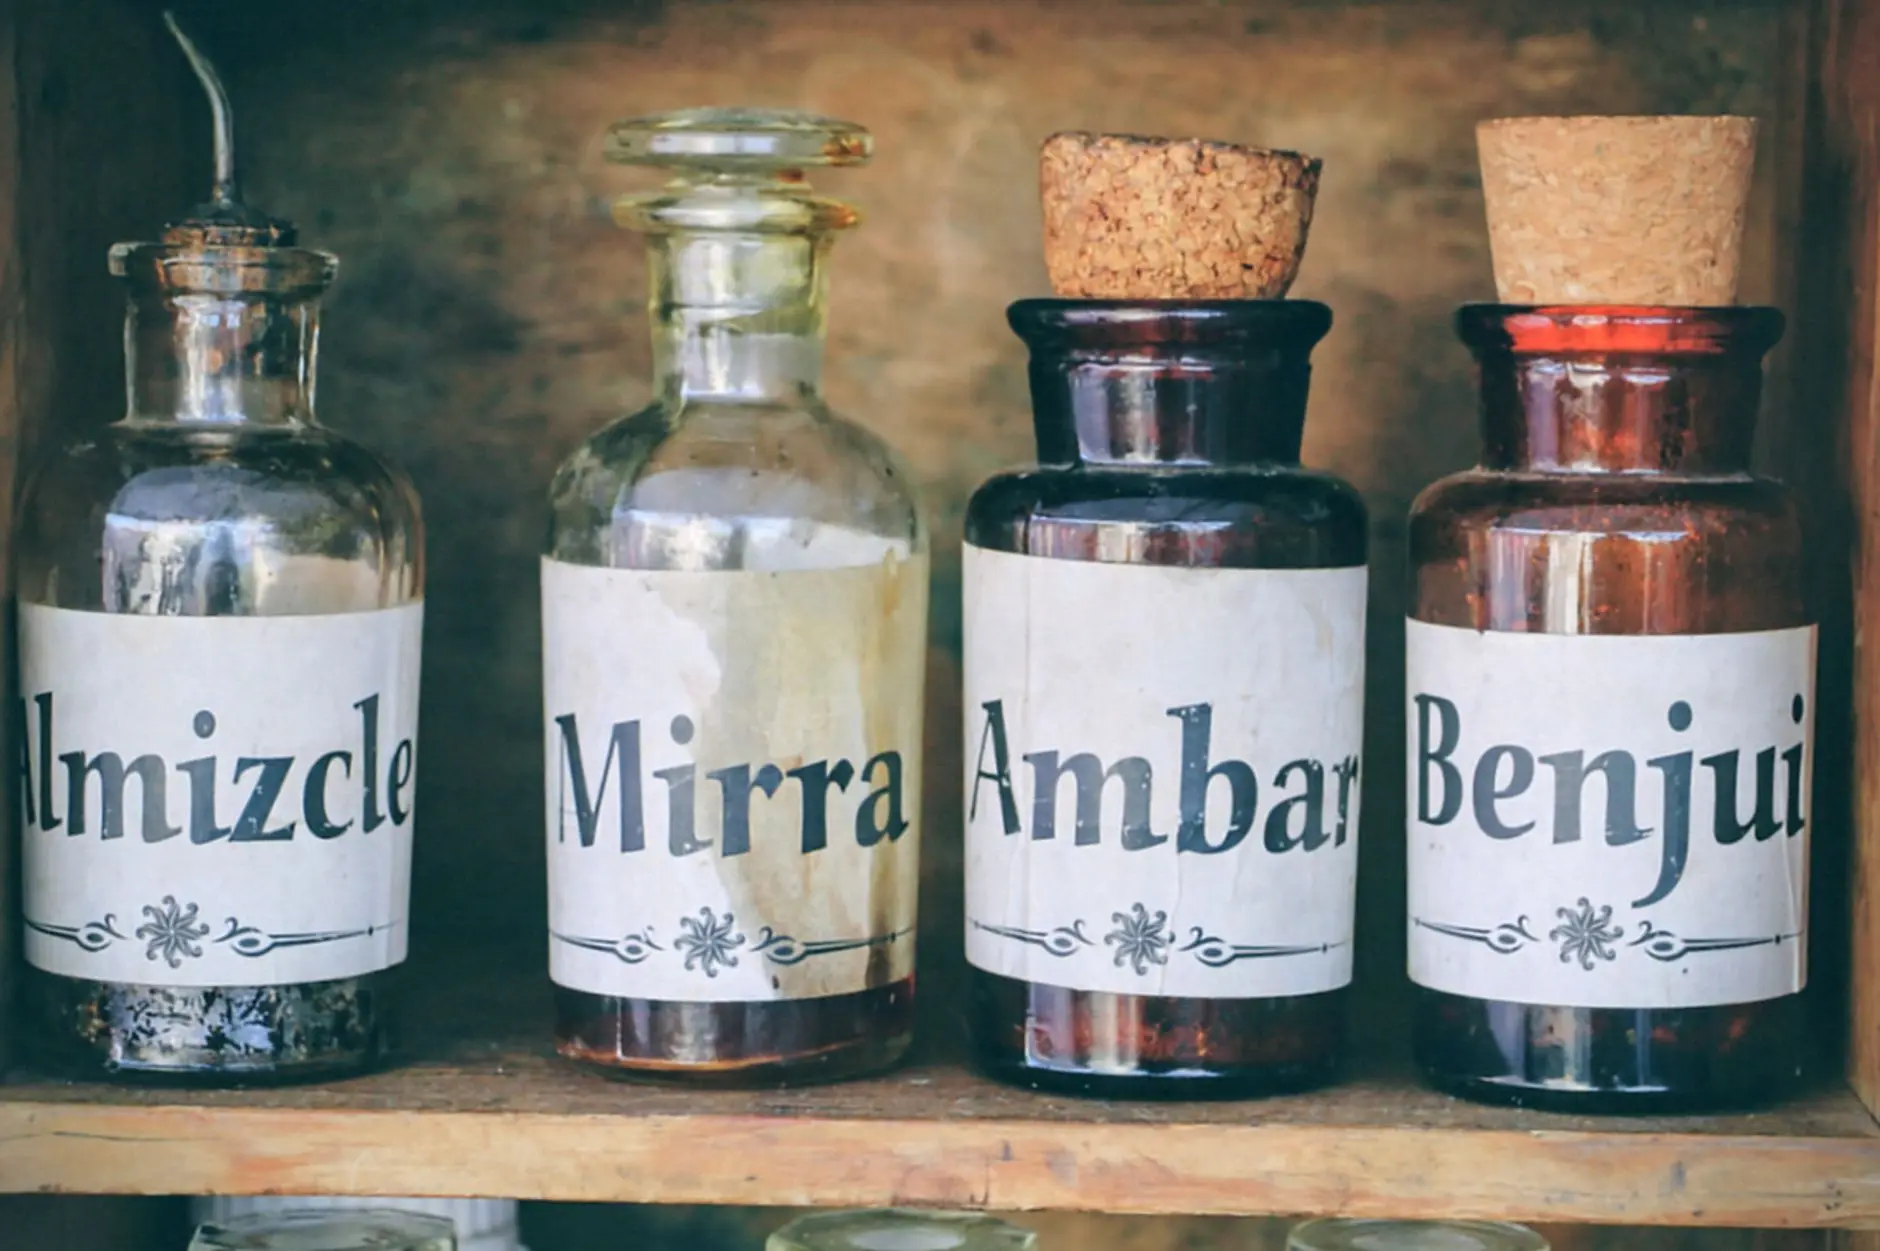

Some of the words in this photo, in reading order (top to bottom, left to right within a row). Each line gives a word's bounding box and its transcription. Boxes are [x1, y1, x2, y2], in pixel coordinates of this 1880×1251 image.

[555, 712, 909, 857] Mirra
[969, 698, 1358, 855] Ambar
[1413, 693, 1805, 908] Benjui
